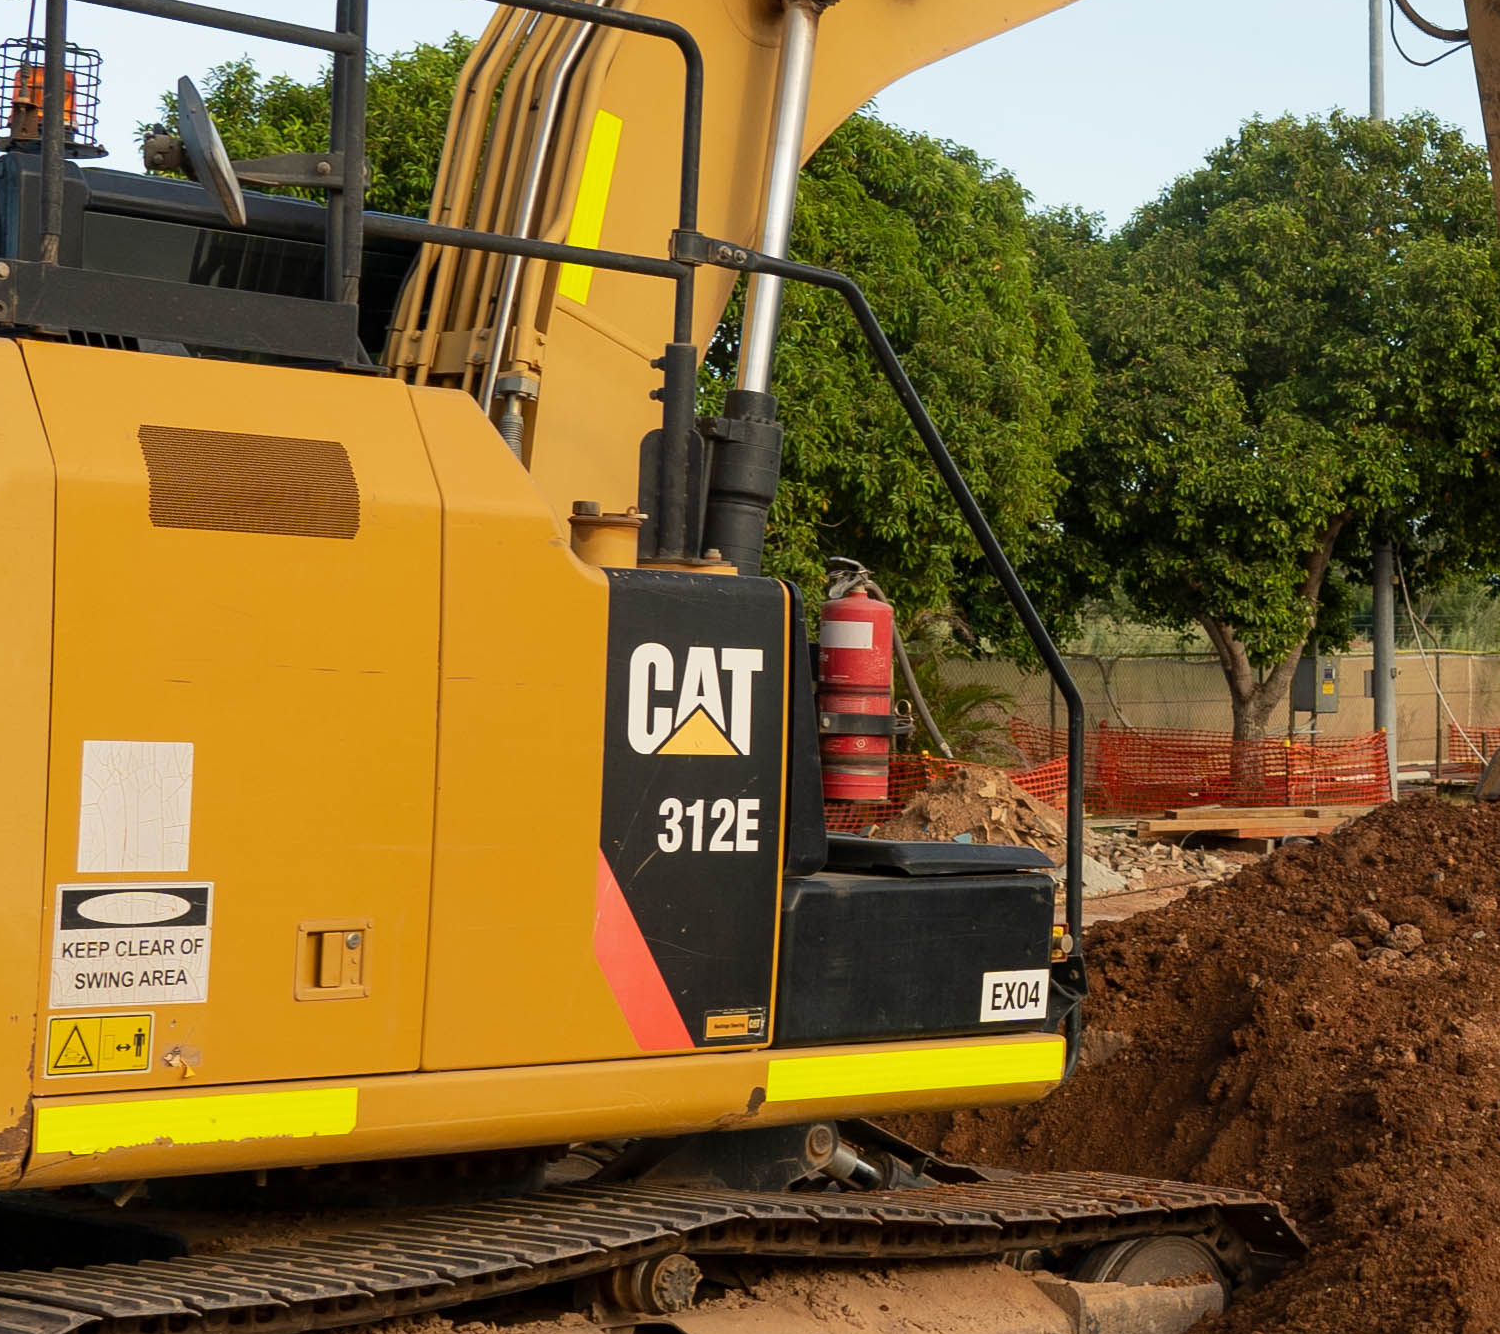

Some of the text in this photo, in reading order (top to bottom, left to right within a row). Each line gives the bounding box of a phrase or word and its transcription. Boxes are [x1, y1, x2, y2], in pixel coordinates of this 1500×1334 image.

[627, 642, 764, 756] CAT
[657, 797, 761, 853] 312E
[62, 938, 204, 959] KEEP CLEAR OF
[74, 969, 188, 990] SWING AREA
[991, 980, 1040, 1011] EX04
